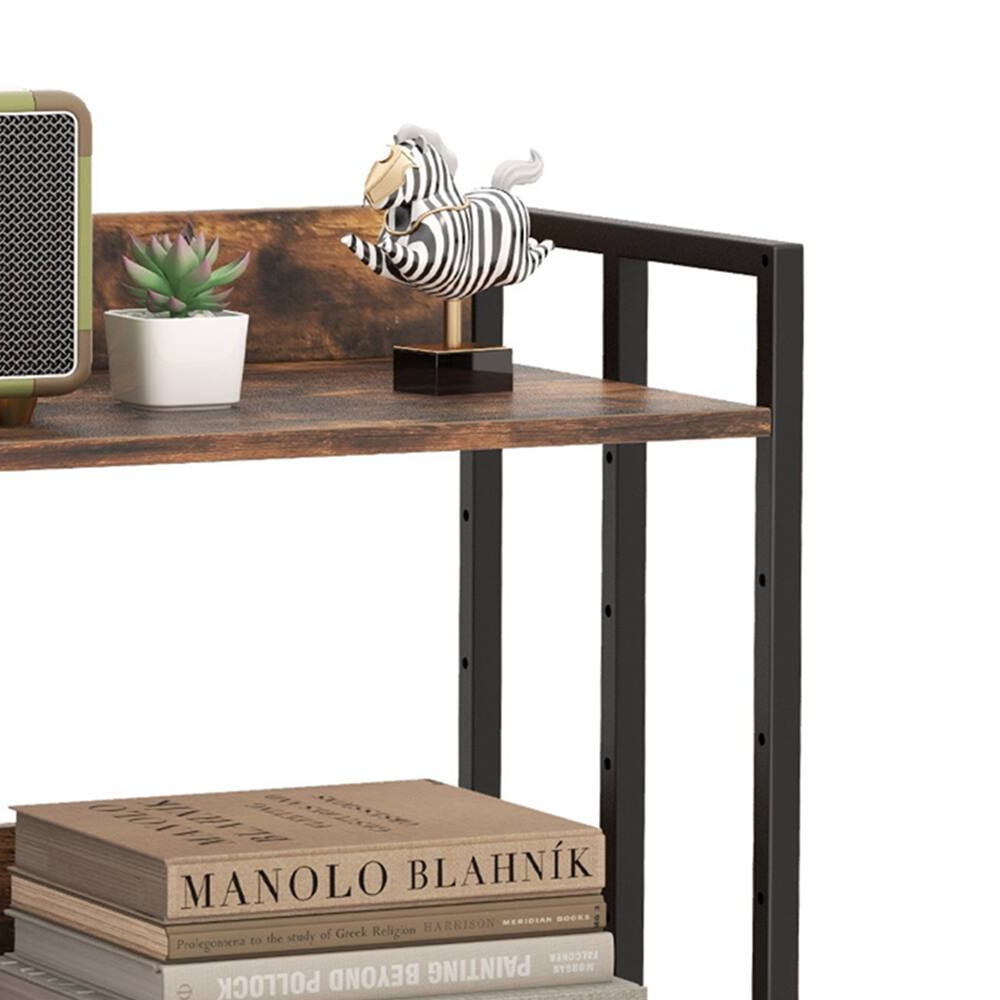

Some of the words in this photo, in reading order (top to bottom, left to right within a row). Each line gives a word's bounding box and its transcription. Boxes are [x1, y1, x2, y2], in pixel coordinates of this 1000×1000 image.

[180, 860, 388, 910] MANOLO
[407, 840, 593, 891] BLAHNÍK
[423, 917, 496, 933] HARRISON
[502, 916, 552, 926] MERIDIAN
[556, 913, 591, 923] BOOKS
[176, 937, 246, 953] Prolegomena
[250, 935, 263, 945] to
[266, 932, 284, 944] the
[287, 929, 316, 947] study
[320, 929, 332, 941] of
[335, 925, 368, 940] Greek
[372, 923, 417, 939] Religion
[329, 963, 420, 992] BEYOND
[428, 953, 532, 985] PAINTING
[217, 970, 321, 1000] POLLOCK
